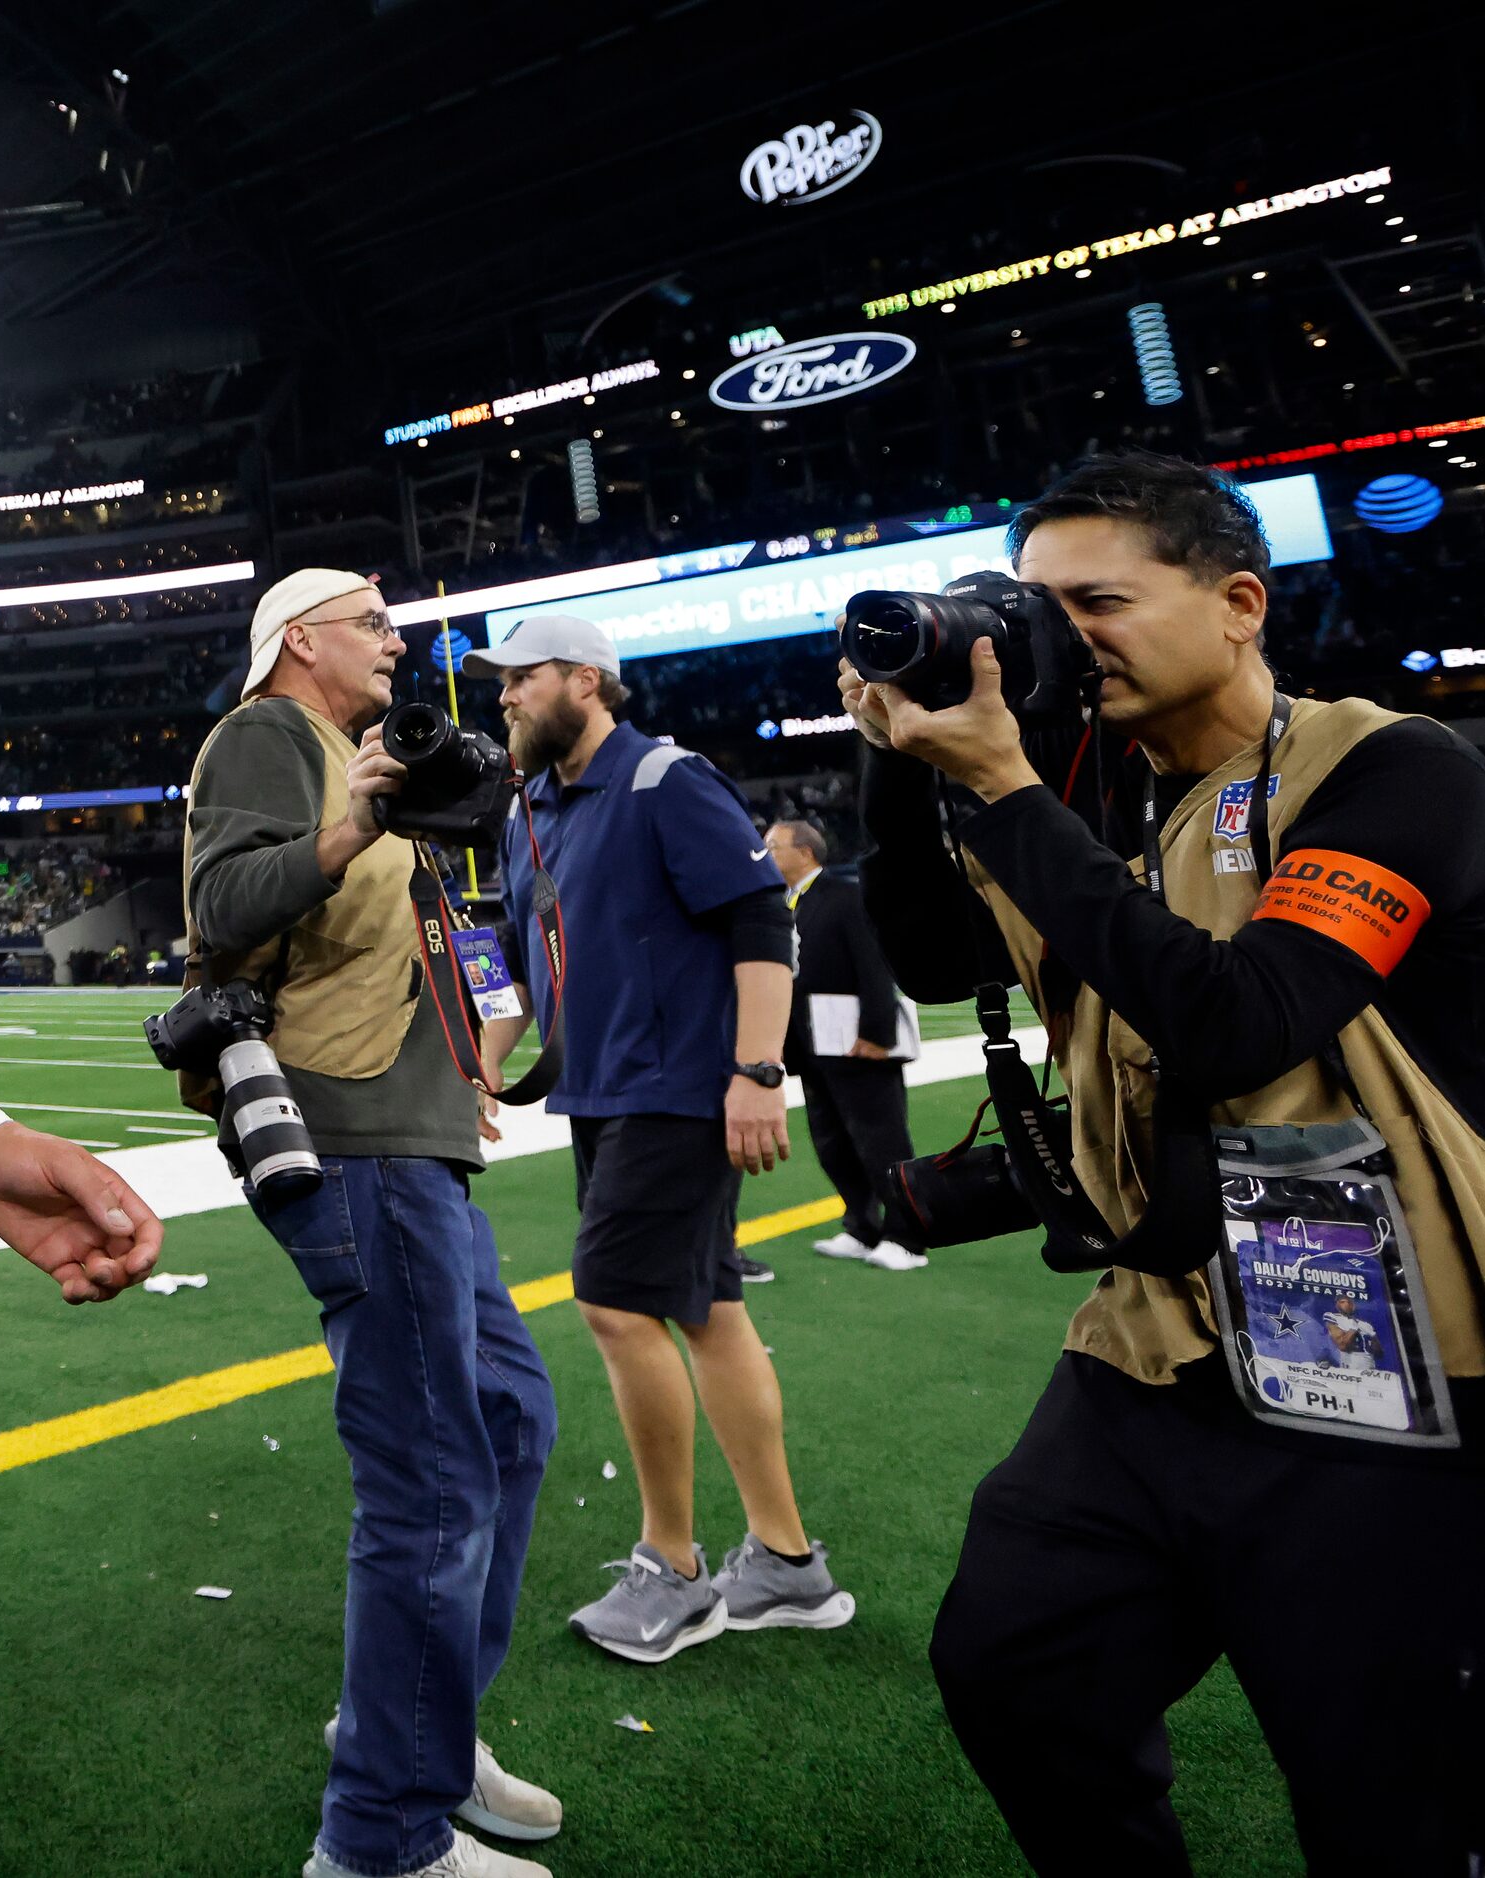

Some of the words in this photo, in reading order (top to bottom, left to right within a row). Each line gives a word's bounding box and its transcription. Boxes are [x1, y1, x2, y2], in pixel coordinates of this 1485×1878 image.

[783, 120, 835, 158] Dr
[753, 124, 871, 204] Pepper
[862, 293, 909, 320] THE
[912, 255, 1051, 308] UNIVERSITY
[1054, 246, 1091, 270] OF
[1091, 223, 1176, 259] TEXAS
[1179, 212, 1216, 237] AT
[1219, 166, 1392, 227] ARLINGTON
[729, 326, 785, 357] UTA
[747, 345, 874, 404] Ford
[385, 414, 452, 445] STUDENTS
[492, 377, 589, 418] EXCELLENCE
[42, 490, 62, 506] AT
[62, 479, 145, 504] ARLINGTON
[946, 584, 977, 597] Canon
[1274, 898, 1293, 908] NFL
[1298, 887, 1340, 906] Field
[1341, 902, 1392, 938] Access
[1325, 870, 1410, 924] CARD
[425, 919, 445, 954] EOS
[1020, 1110, 1073, 1196] Canon
[1256, 1278, 1294, 1290] 2023
[1302, 1284, 1369, 1302] SEASON
[1303, 1268, 1366, 1290] COWBOYS
[1288, 1365, 1310, 1376] NFC
[1311, 1369, 1363, 1384] PLAYOFF
